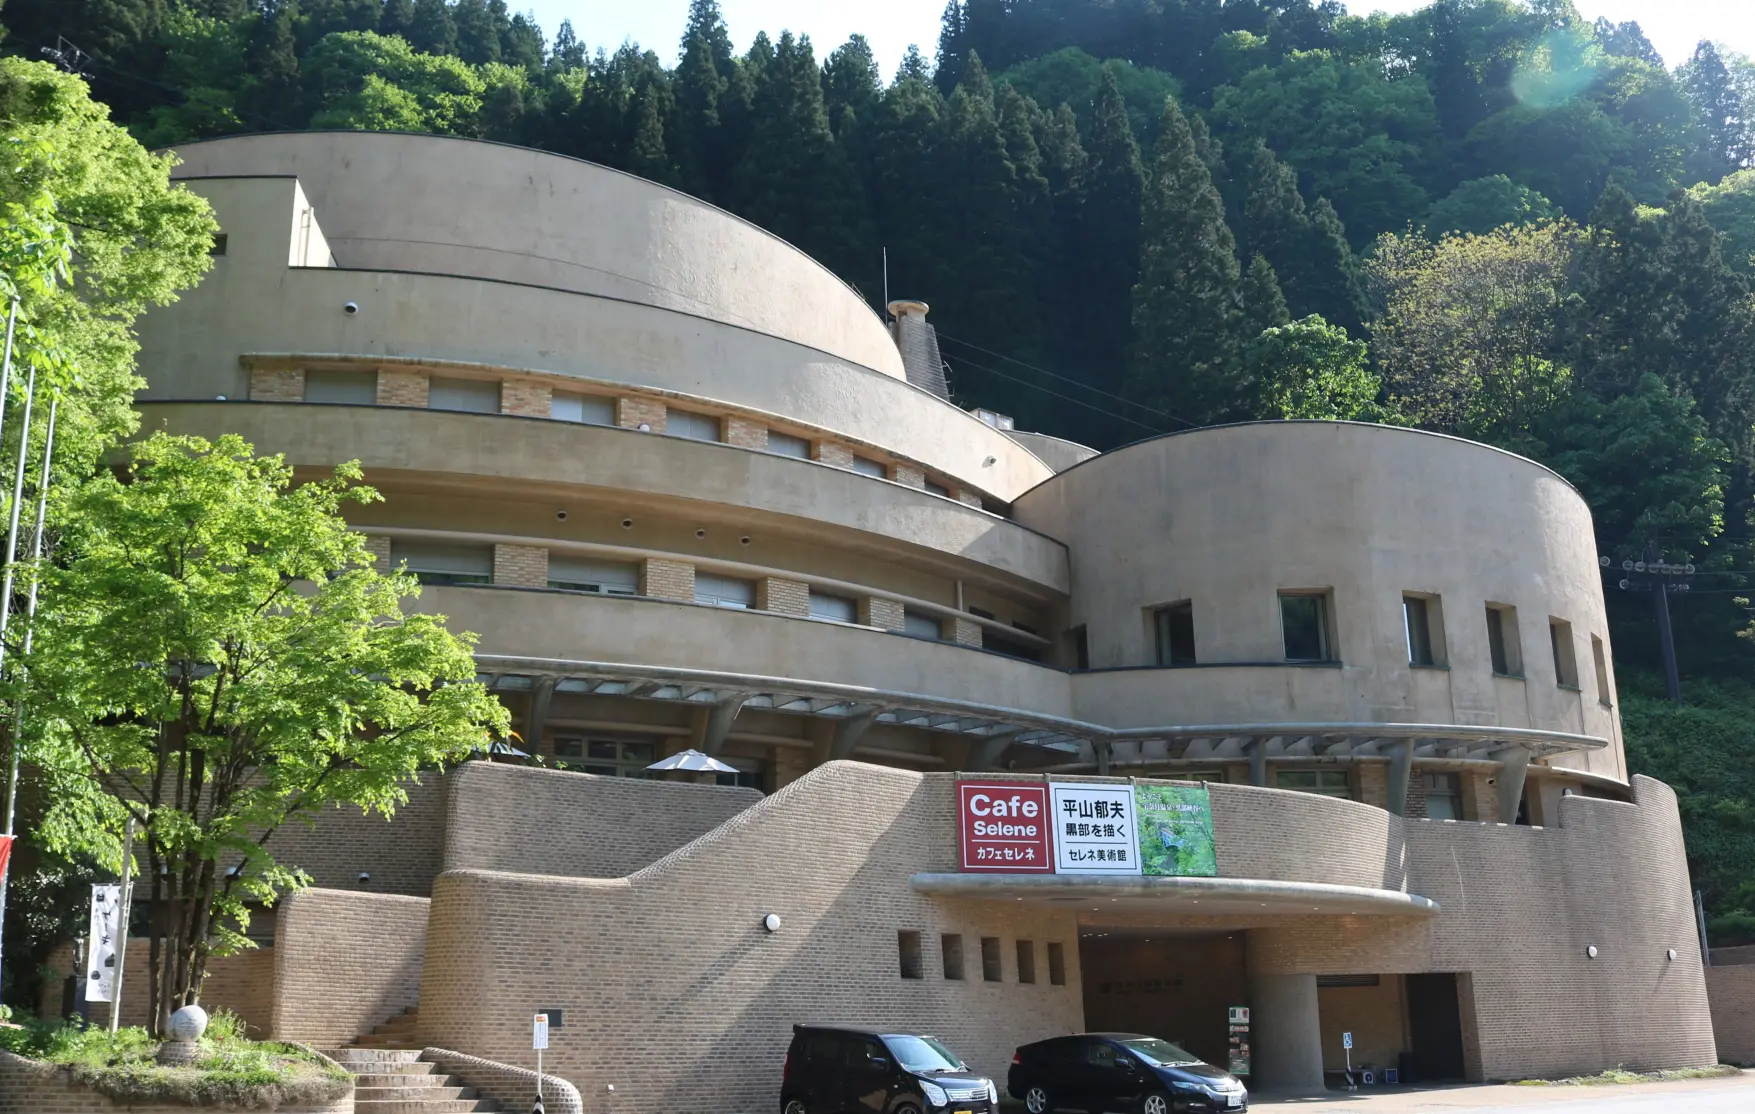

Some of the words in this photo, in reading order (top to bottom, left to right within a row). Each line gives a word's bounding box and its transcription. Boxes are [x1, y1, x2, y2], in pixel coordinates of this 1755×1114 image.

[970, 794, 1038, 817] Cafe
[1063, 799, 1124, 819] 平山郁夫
[974, 821, 1037, 836] Selene
[1066, 823, 1125, 837] 黒部を描く
[977, 847, 1035, 860] カフェセレネ
[1069, 849, 1126, 861] セレネ美術館
